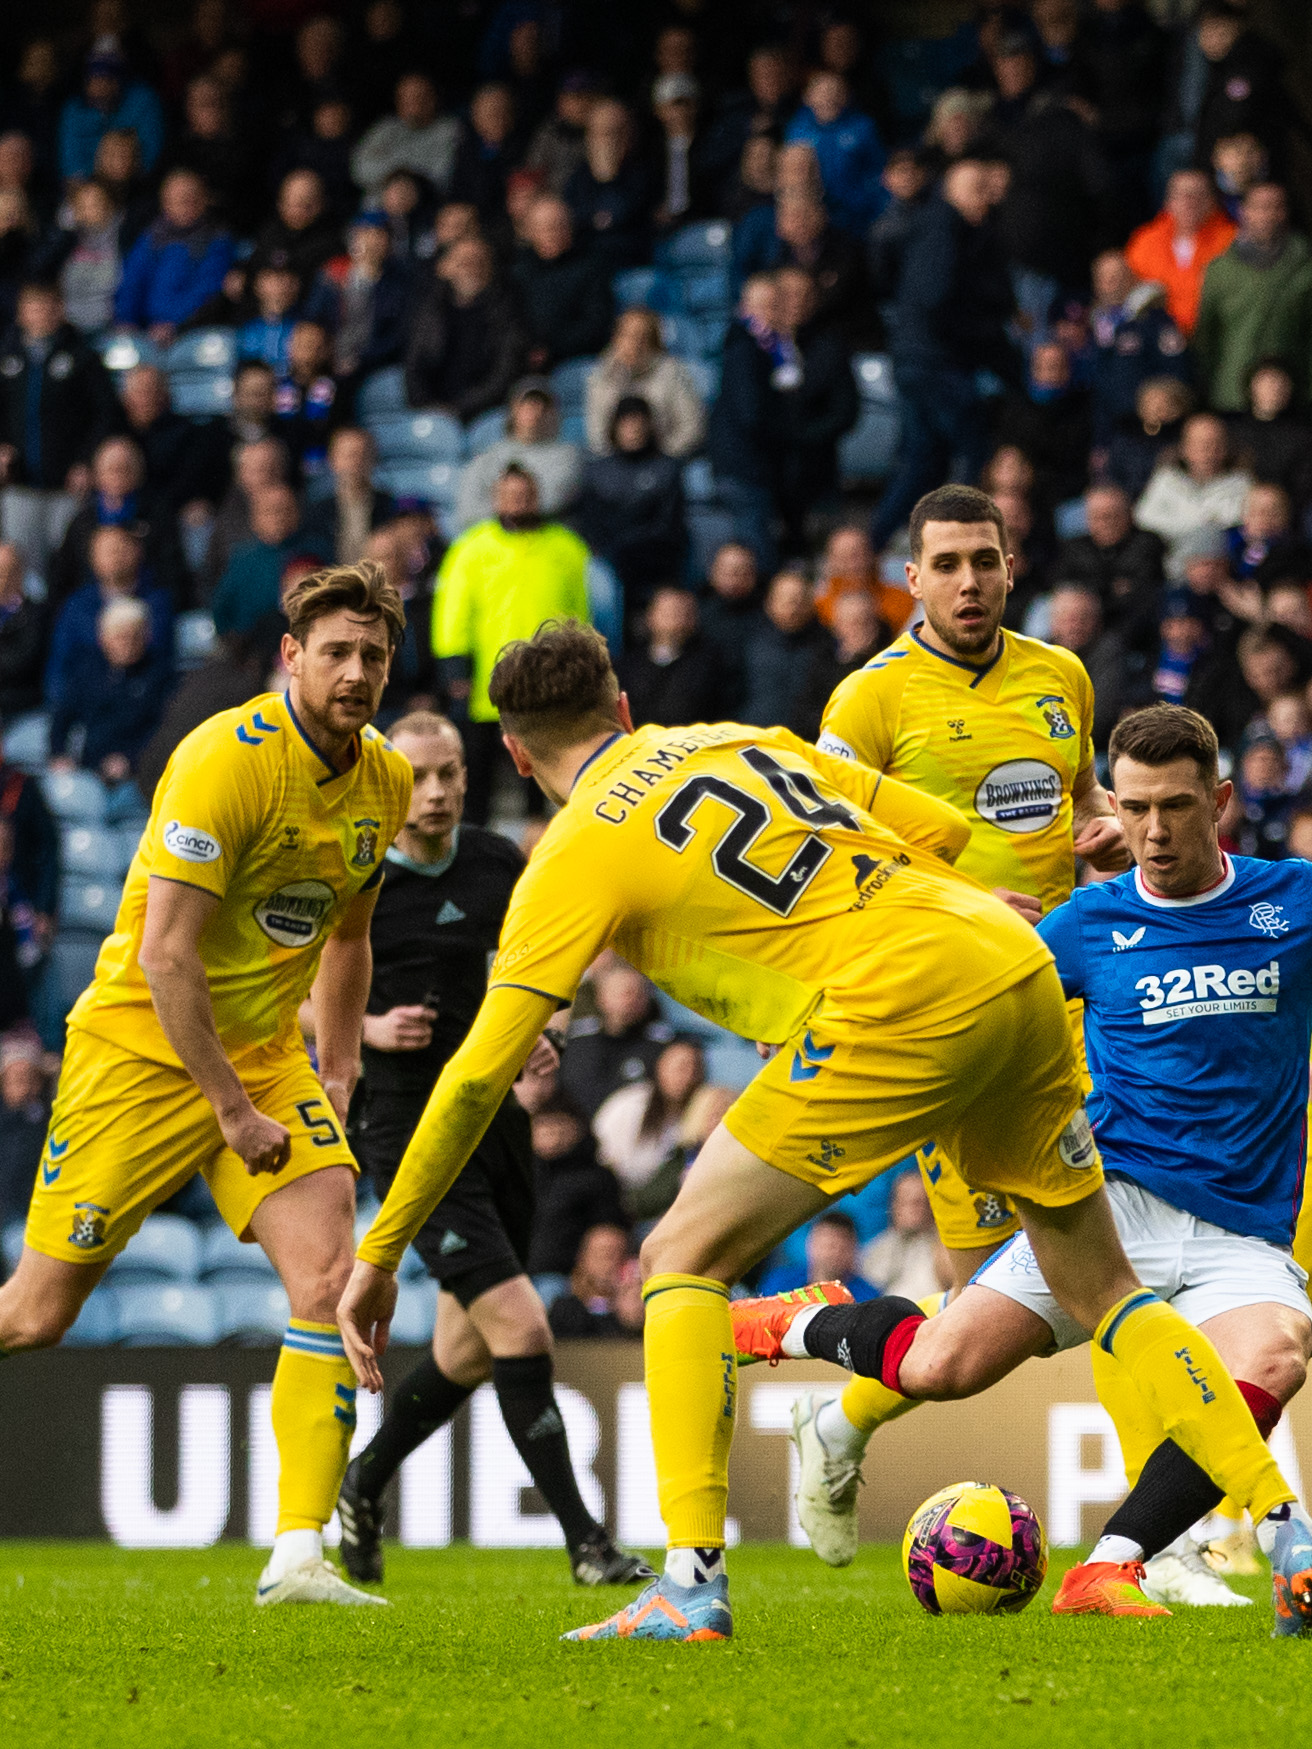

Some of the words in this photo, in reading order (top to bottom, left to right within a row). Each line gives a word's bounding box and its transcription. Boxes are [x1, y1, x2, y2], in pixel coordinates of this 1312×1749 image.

[986, 775, 1056, 808] BROWNINGS
[653, 744, 865, 919] 24
[1000, 810, 1017, 818] THE
[176, 834, 215, 854] cinch
[1135, 961, 1280, 1010] 32Red
[1166, 1008, 1186, 1019] SET
[1188, 1004, 1220, 1014] YOUR
[1223, 1001, 1258, 1011] LIMITS
[295, 1099, 340, 1148] 5
[1174, 1346, 1217, 1404] KILLIE
